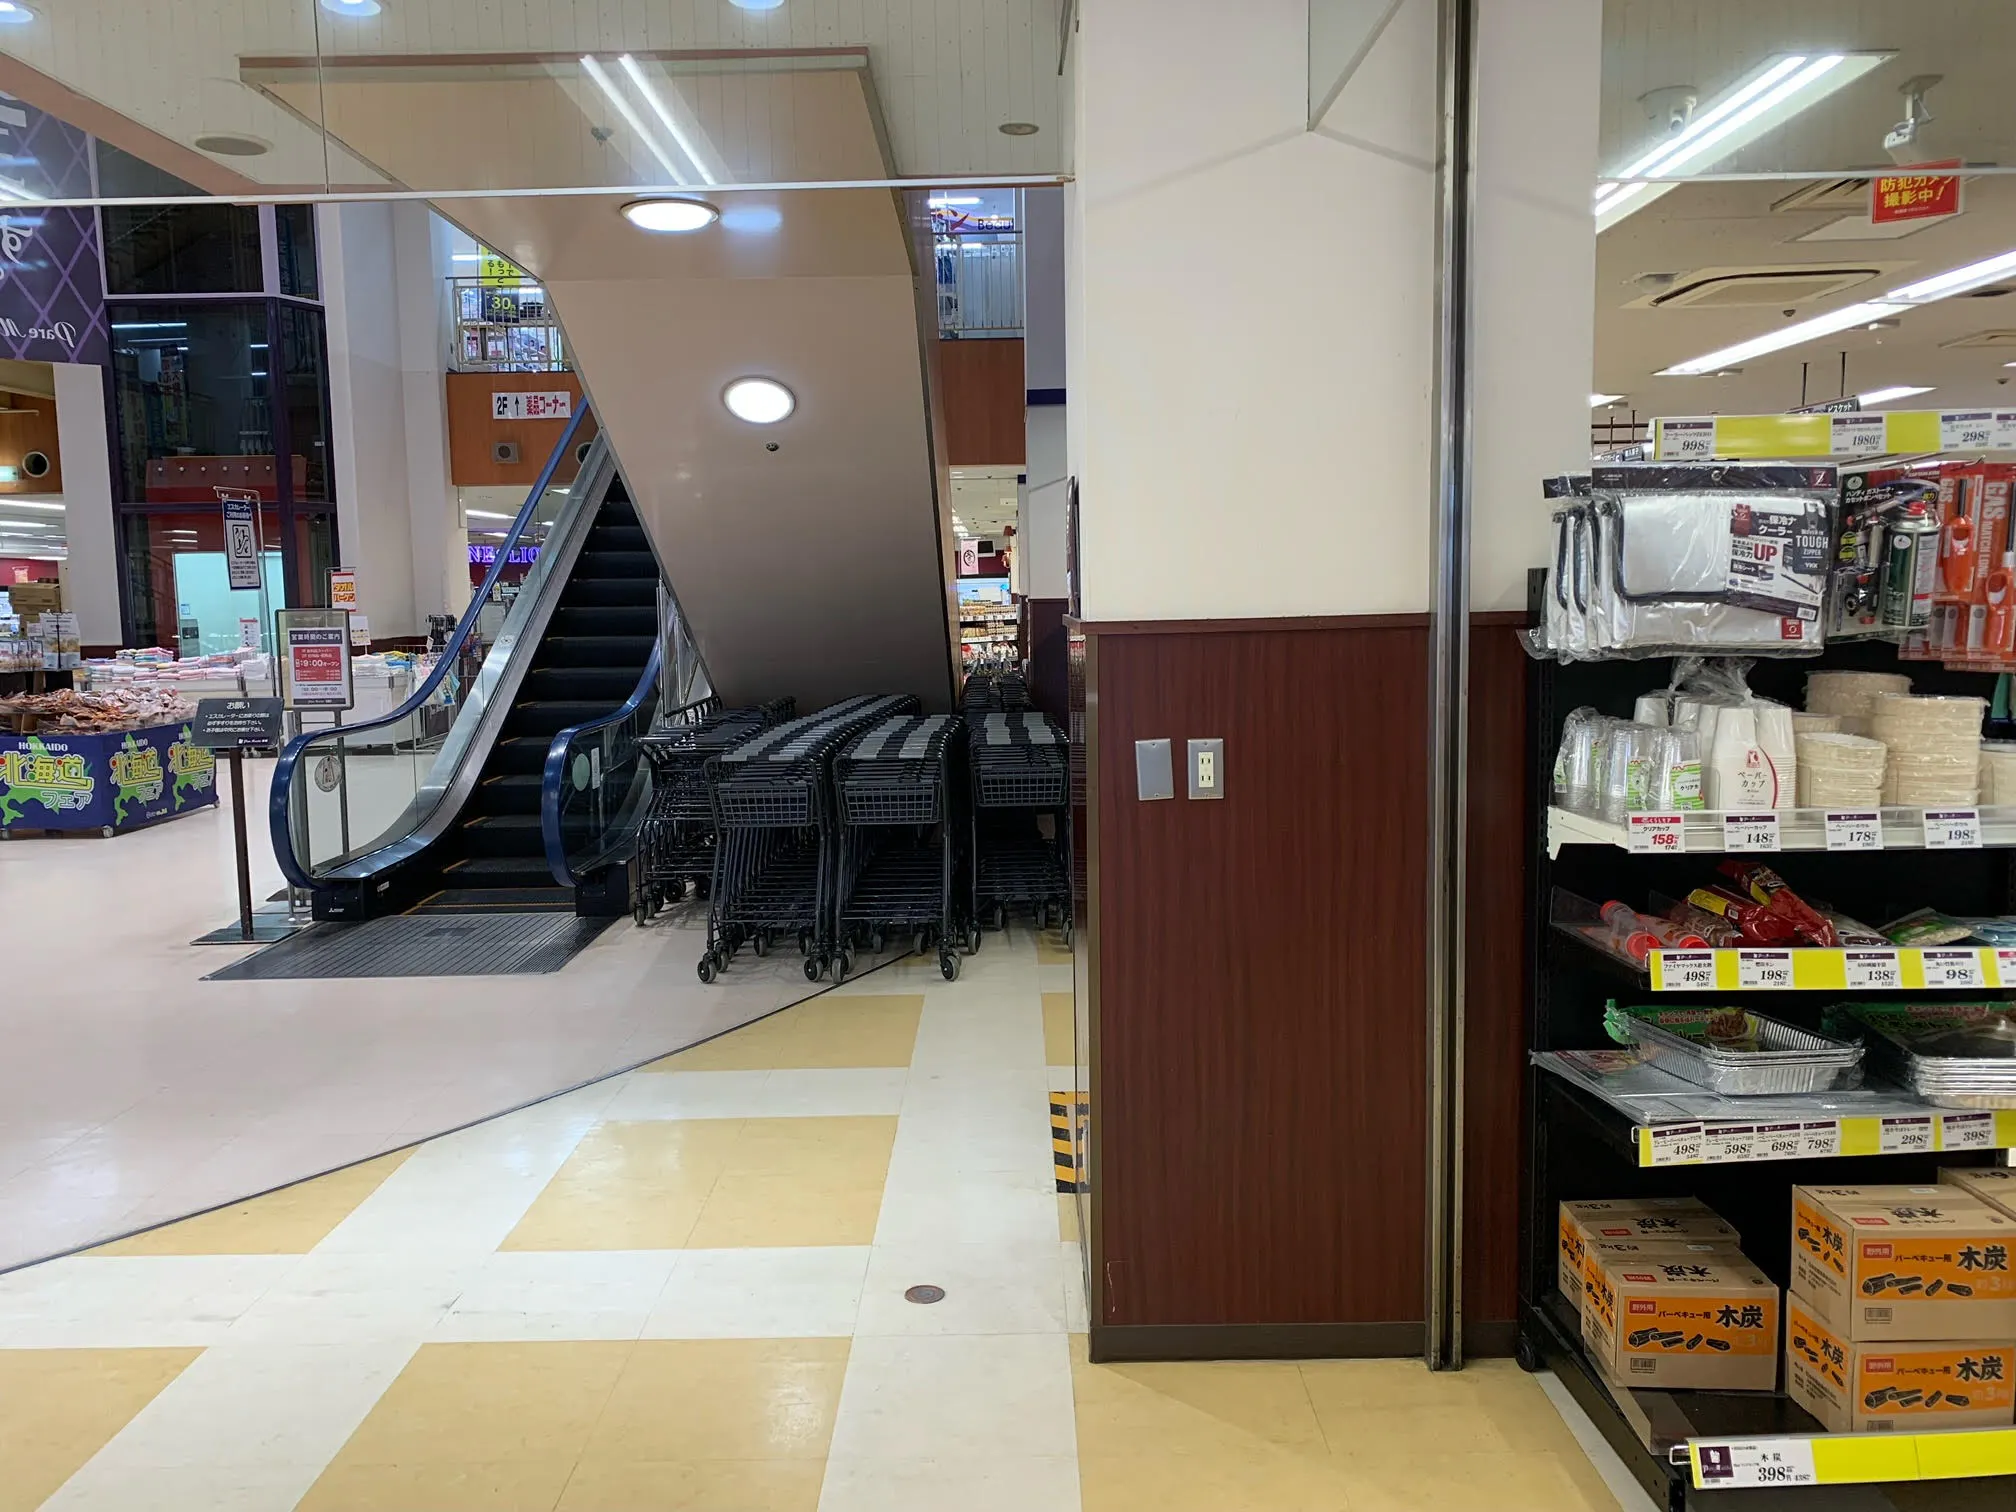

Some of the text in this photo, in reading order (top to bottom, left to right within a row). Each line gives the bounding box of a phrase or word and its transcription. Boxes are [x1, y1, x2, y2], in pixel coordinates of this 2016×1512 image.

[497, 396, 508, 415] 2F
[1852, 434, 1876, 446] 1980
[1962, 430, 1985, 442] 298
[1682, 439, 1705, 451] 998
[1983, 482, 2008, 519] GAS
[1796, 536, 1829, 549] TOUGH
[1980, 521, 1993, 552] MATCH
[1754, 543, 1778, 561] UP
[18, 741, 69, 752] HOKKAIDO
[0, 751, 94, 791] 北海道
[109, 746, 164, 787] 北海道
[1738, 771, 1768, 780] ペーパー
[41, 791, 93, 811] フェア
[1652, 834, 1674, 845] 158
[1747, 832, 1768, 844] 148
[1849, 831, 1871, 842] 178
[1948, 829, 1970, 840] 198
[1683, 970, 1705, 982] 498
[1761, 970, 1783, 981] 198
[1868, 970, 1890, 981] 138
[1946, 969, 1969, 980] 98
[1901, 1134, 1923, 1145] 298
[1963, 1130, 1986, 1142] 398
[1673, 1143, 1695, 1156] 498
[1724, 1143, 1747, 1155] 598
[1771, 1141, 1793, 1152] 698
[1807, 1138, 1830, 1149] 798
[1895, 1254, 1953, 1263] バーベキュー用
[1957, 1245, 2009, 1271] 木炭
[1632, 1303, 1764, 1329] 野外用 バーベキュー用 木炭
[1896, 1365, 1952, 1375] バーベキュー用
[1956, 1355, 2005, 1382] 木炭
[1758, 1466, 1786, 1482] 398
